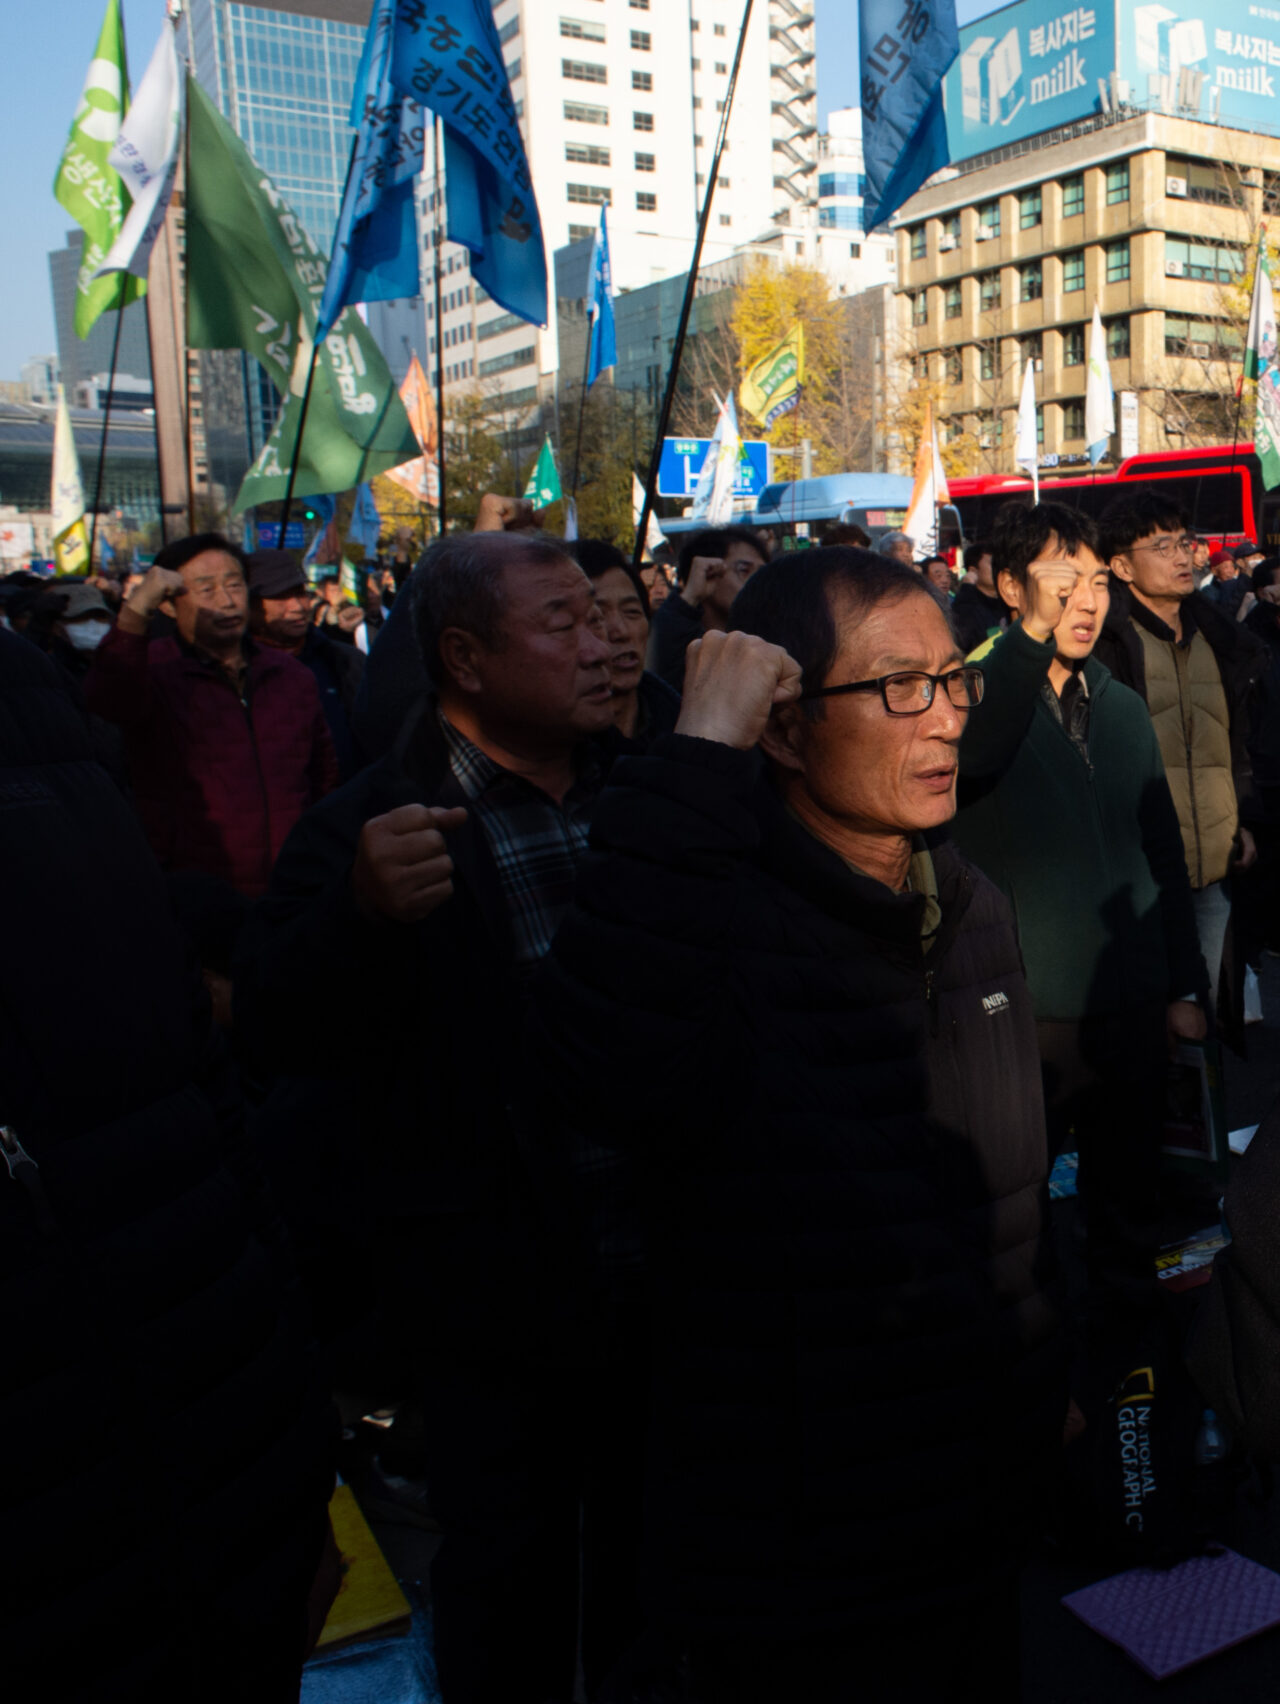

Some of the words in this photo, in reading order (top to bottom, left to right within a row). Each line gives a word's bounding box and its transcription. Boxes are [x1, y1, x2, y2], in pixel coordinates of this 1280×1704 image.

[1029, 6, 1096, 57] 복사지는
[1030, 48, 1087, 105] miilk
[1216, 65, 1275, 98] miilk
[1117, 1406, 1145, 1528] GEOGRAPHC
